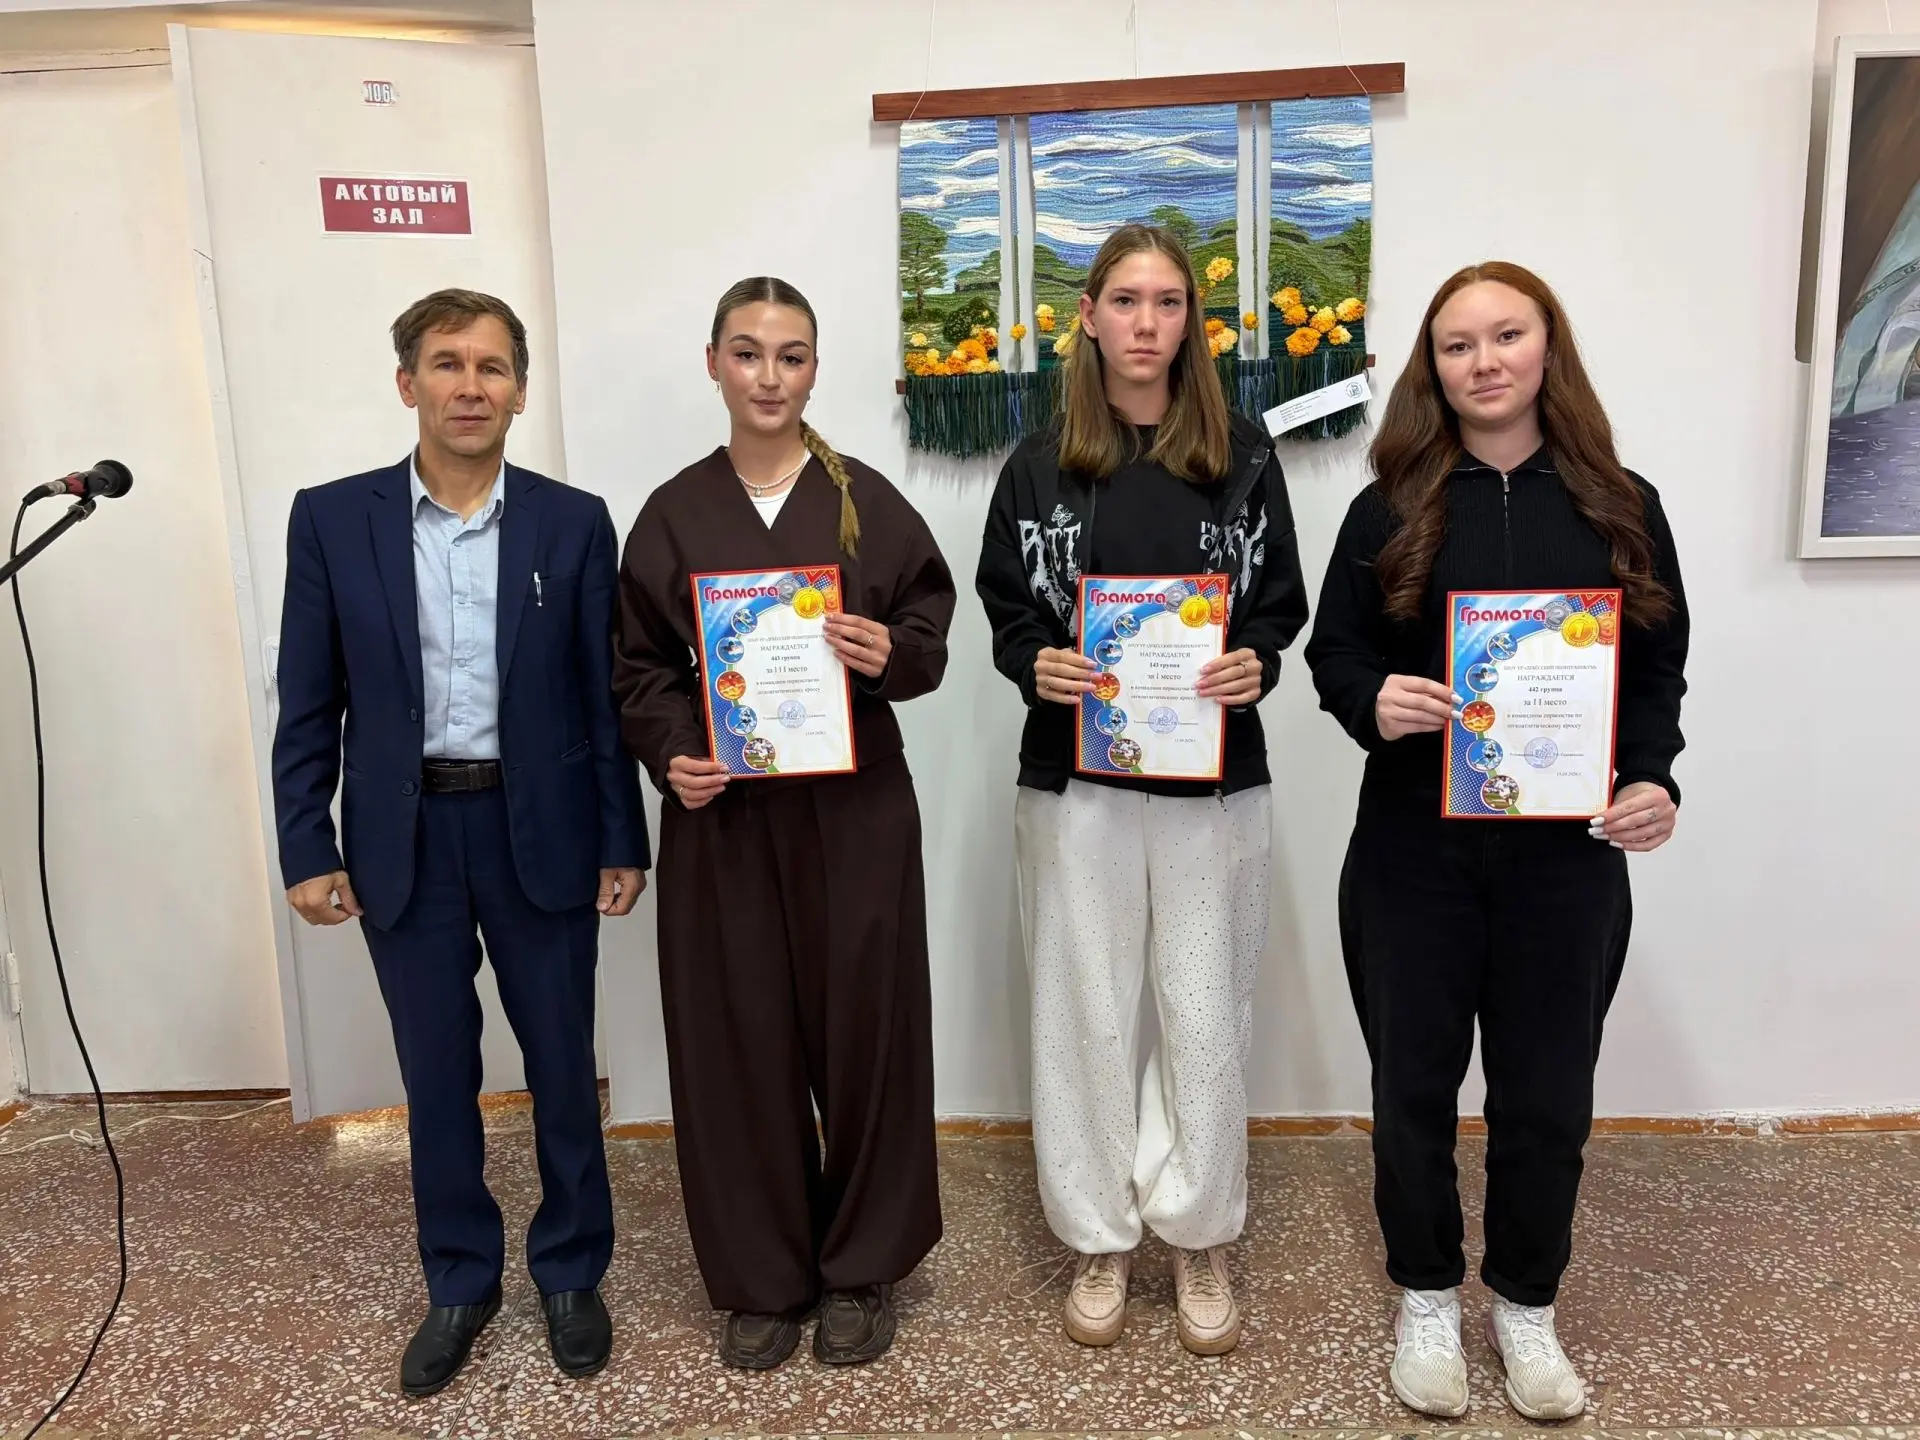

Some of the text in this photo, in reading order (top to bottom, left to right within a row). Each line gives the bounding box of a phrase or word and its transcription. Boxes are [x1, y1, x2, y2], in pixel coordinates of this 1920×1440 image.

[366, 83, 392, 103] 106
[335, 184, 457, 203] АКТОВЫЙ
[373, 207, 424, 225] ЗАЛ
[704, 585, 779, 604] Грамота
[1090, 588, 1167, 606] Грамота
[1460, 605, 1546, 625] Грамота
[760, 643, 809, 652] НАГРАЖДАЕТСЯ
